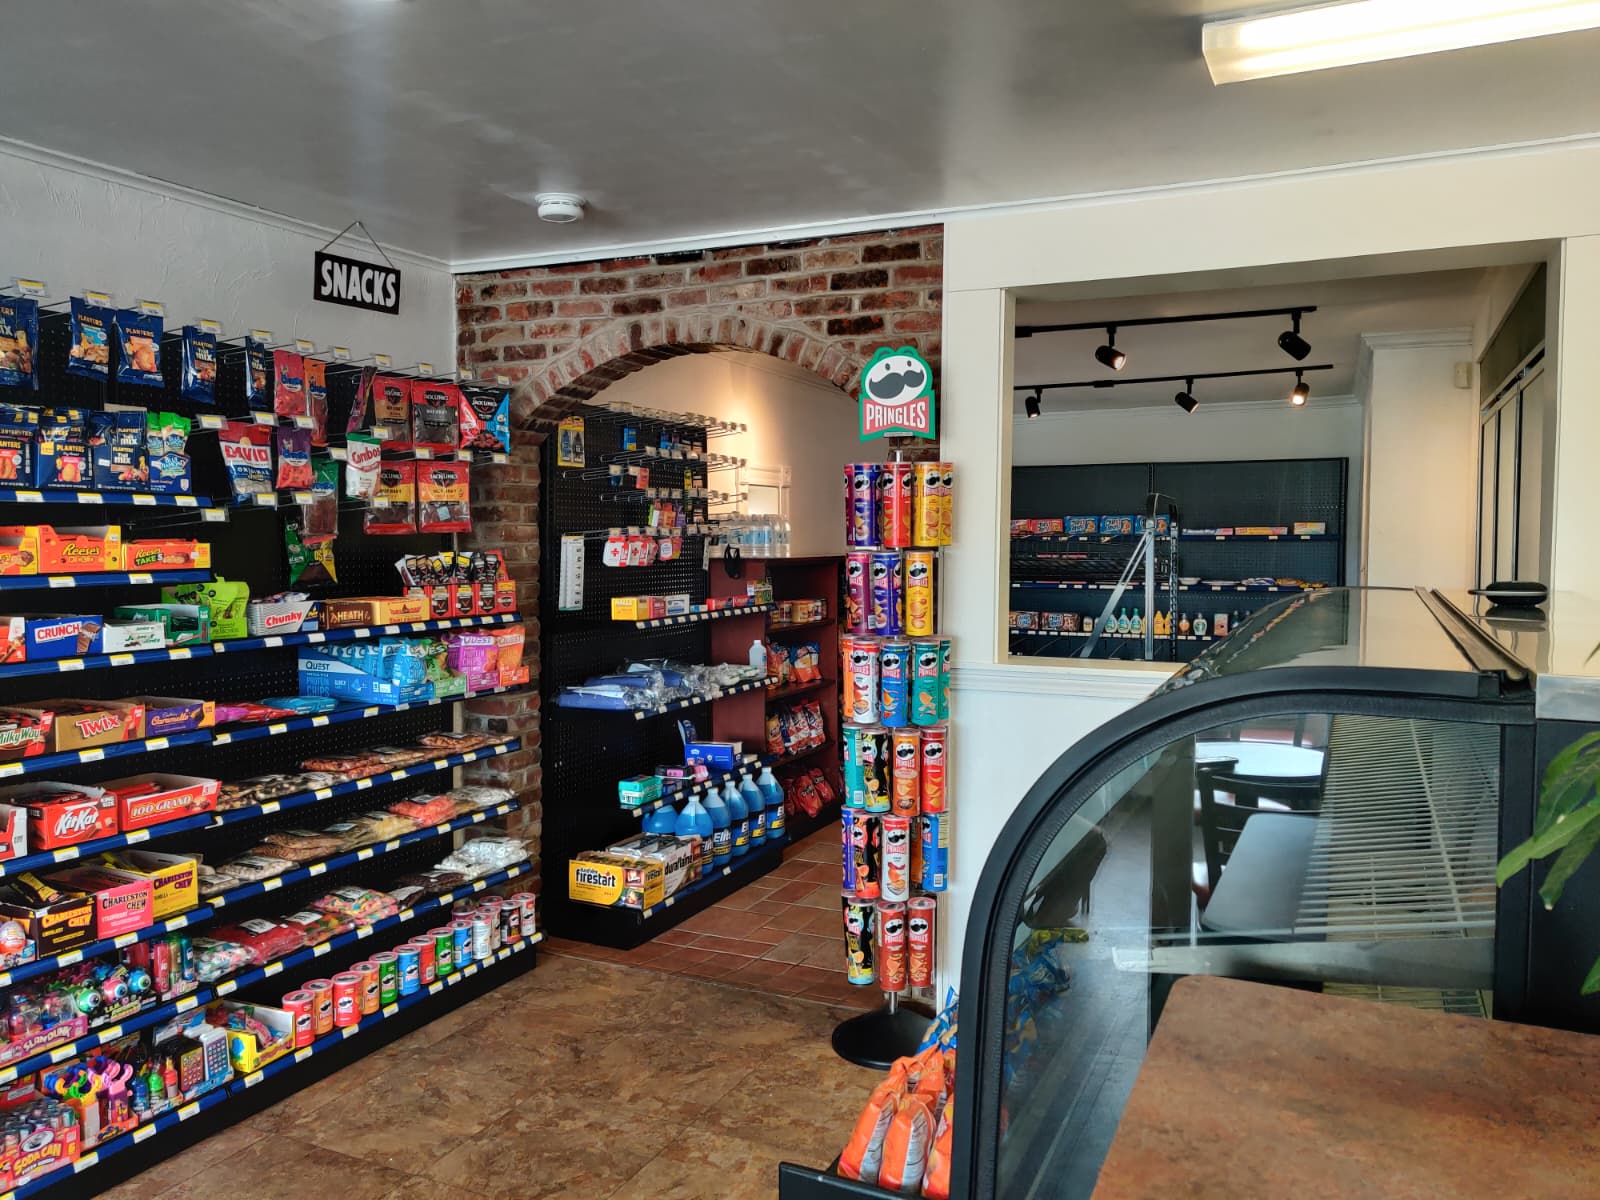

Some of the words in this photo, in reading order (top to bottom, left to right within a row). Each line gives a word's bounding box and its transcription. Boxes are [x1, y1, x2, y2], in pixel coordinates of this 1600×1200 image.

[320, 259, 396, 307] SNACKS
[866, 401, 926, 430] PRINGLES
[56, 443, 86, 453] PLANTERS
[224, 445, 269, 462] DAVID
[135, 555, 157, 565] TAKE
[264, 611, 303, 628] Chunky
[337, 610, 364, 622] HEATH
[36, 623, 80, 639] CRUNCH
[305, 661, 331, 670] QUEST
[76, 714, 120, 738] Twix
[133, 804, 154, 817] 100
[155, 795, 193, 811] GRAND
[55, 809, 99, 836] KitKat
[664, 854, 693, 875] duraflame
[154, 870, 193, 890] CHARLESTON
[174, 878, 193, 889] CHEW
[575, 868, 616, 887] firestart
[102, 890, 148, 909] CHARLESTON
[126, 899, 147, 910] CHEW
[41, 905, 92, 928] CHARLESTON
[68, 914, 92, 927] CHEW
[23, 1034, 48, 1052] SLAM
[47, 1024, 73, 1041] DUNK
[13, 1150, 41, 1177] SODA
[41, 1143, 62, 1157] CAN
